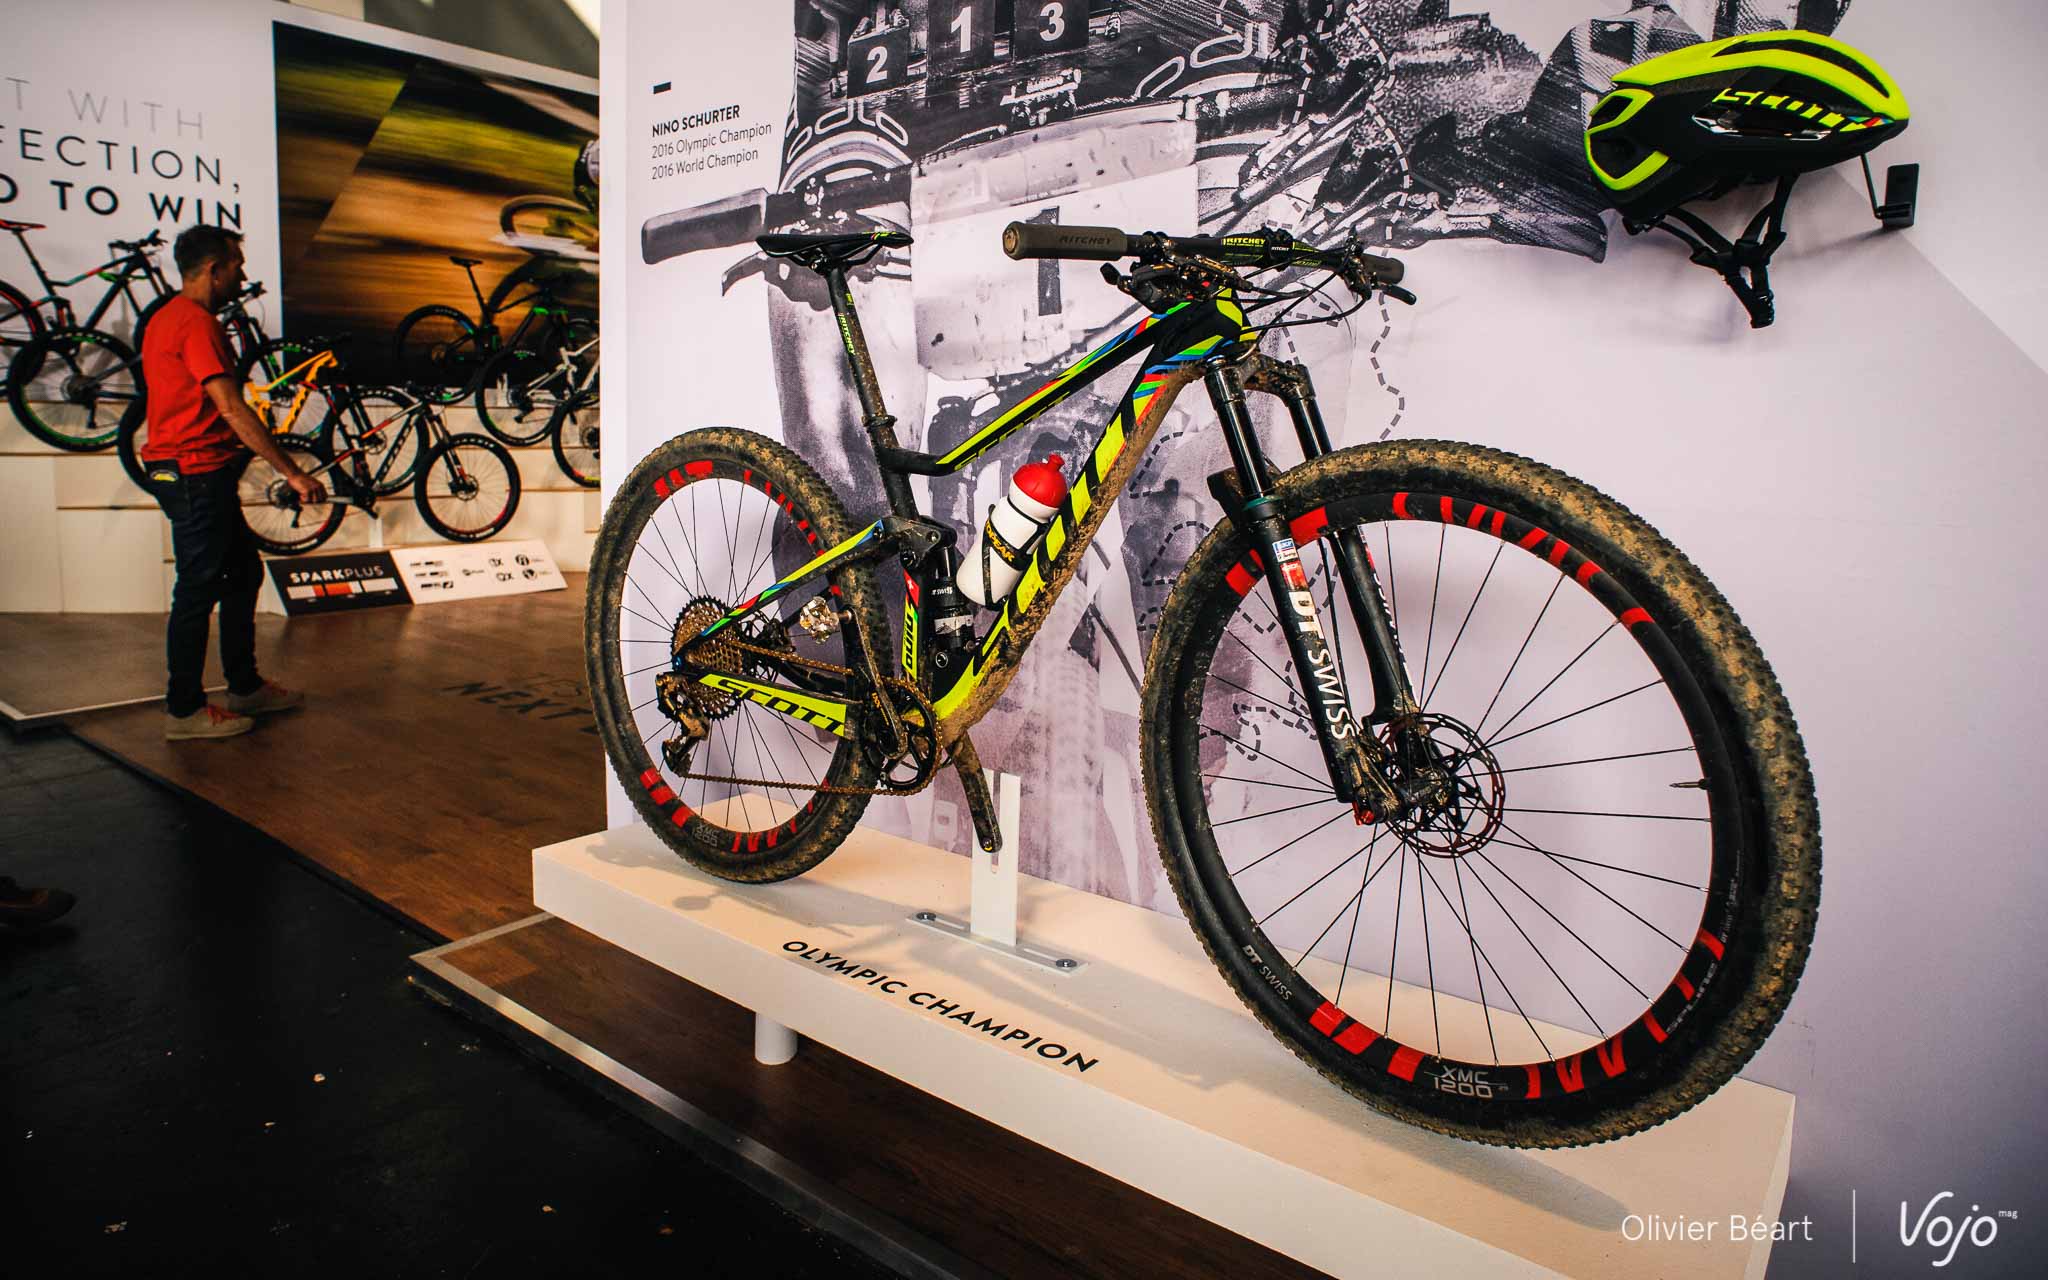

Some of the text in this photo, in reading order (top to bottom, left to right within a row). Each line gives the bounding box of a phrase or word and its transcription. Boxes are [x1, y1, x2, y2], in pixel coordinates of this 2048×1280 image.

[951, 6, 972, 53] 1
[1040, 2, 1066, 42] 3
[866, 46, 888, 84] 2
[68, 88, 203, 140] WITH
[652, 104, 741, 138] NINO SCHURTER
[0, 125, 239, 193] ECTION,
[652, 122, 772, 159] 2016 Olympic Champion
[652, 148, 759, 180] 2016 World Champion
[50, 179, 119, 216] TO
[149, 192, 242, 230] WIN
[1226, 237, 1266, 245] RITCHEY
[1288, 591, 1325, 640] DT
[1307, 648, 1356, 739] SWISS
[717, 678, 847, 734] SCOTT
[1242, 944, 1293, 1001] DT SWISS
[782, 940, 1100, 1073] OLYMPIC CHAMPION
[1433, 1076, 1494, 1099] 1200
[1440, 1064, 1489, 1085] XMC
